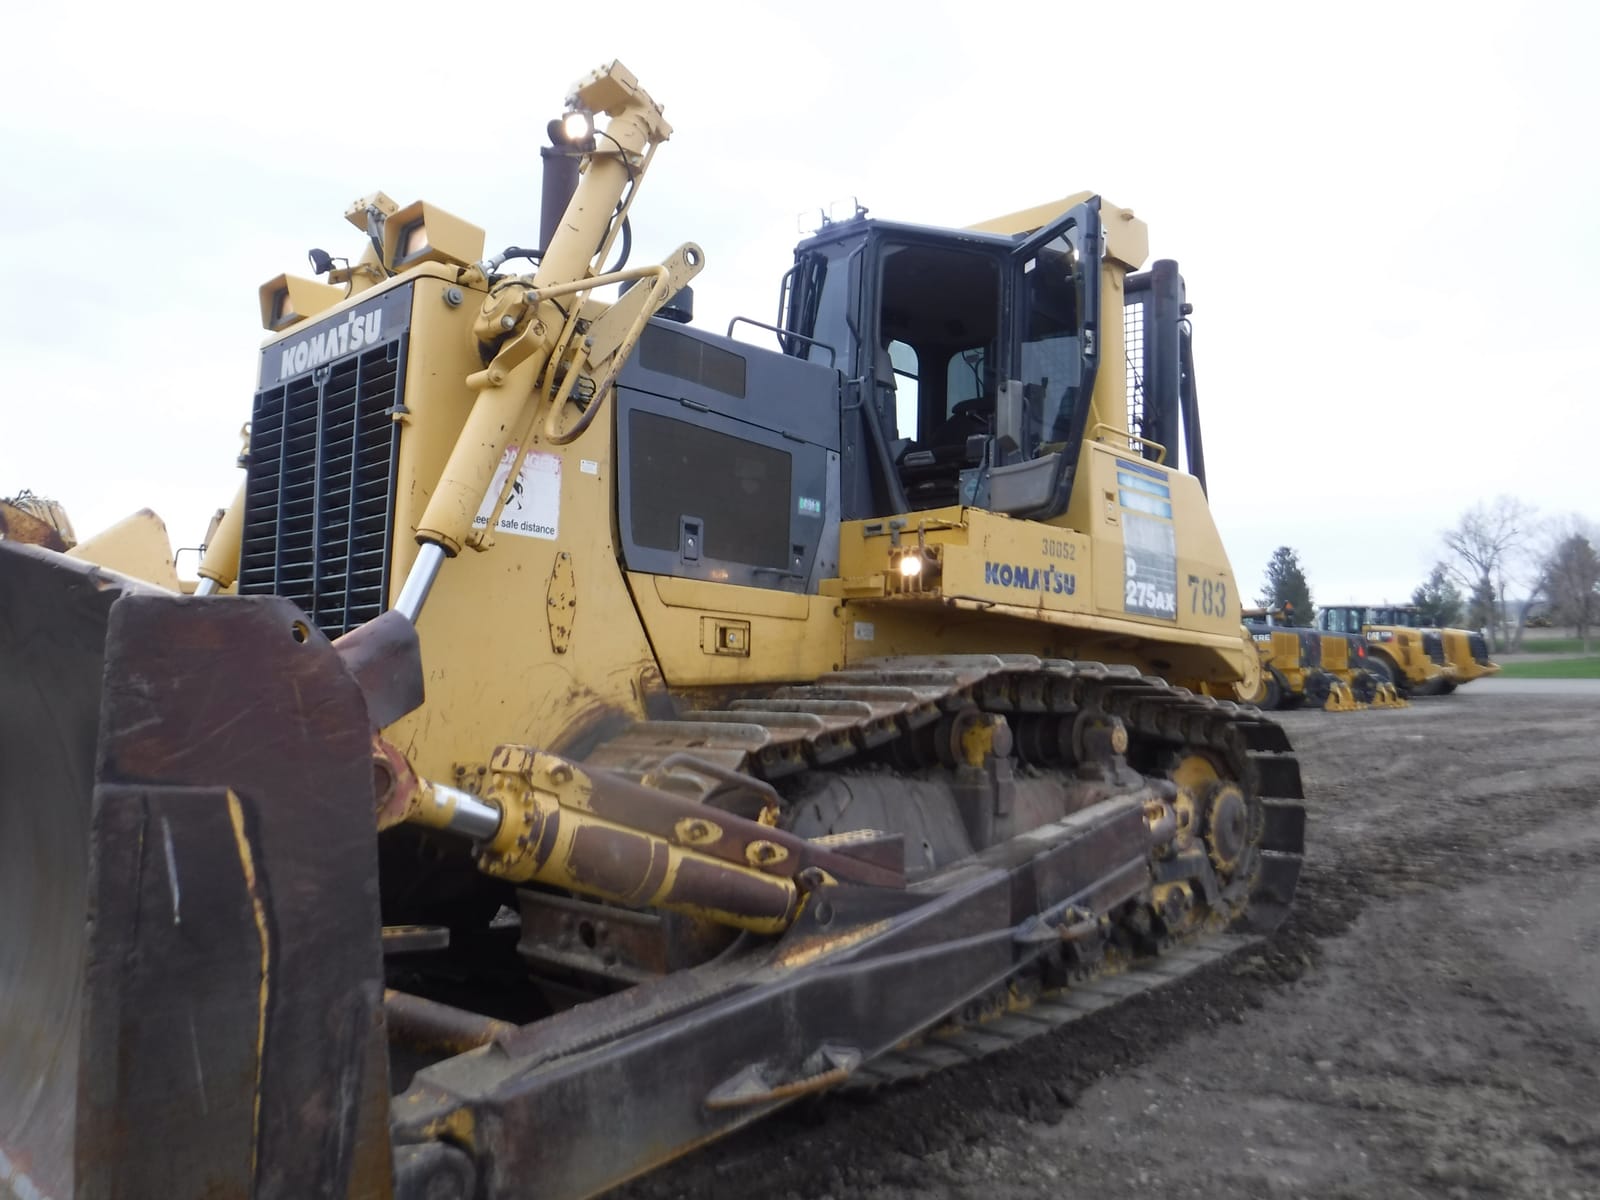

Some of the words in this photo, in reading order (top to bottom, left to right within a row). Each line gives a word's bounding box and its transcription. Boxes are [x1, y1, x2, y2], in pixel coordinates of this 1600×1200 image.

[280, 308, 382, 380] KOMATSU
[501, 519, 519, 530] safe
[520, 521, 555, 535] distance
[1042, 538, 1076, 561] 30052
[985, 561, 1076, 596] KOMATSU
[1126, 557, 1137, 577] D
[1125, 579, 1175, 612] 275AX
[1188, 574, 1226, 619] 783
[1253, 634, 1271, 642] ERE
